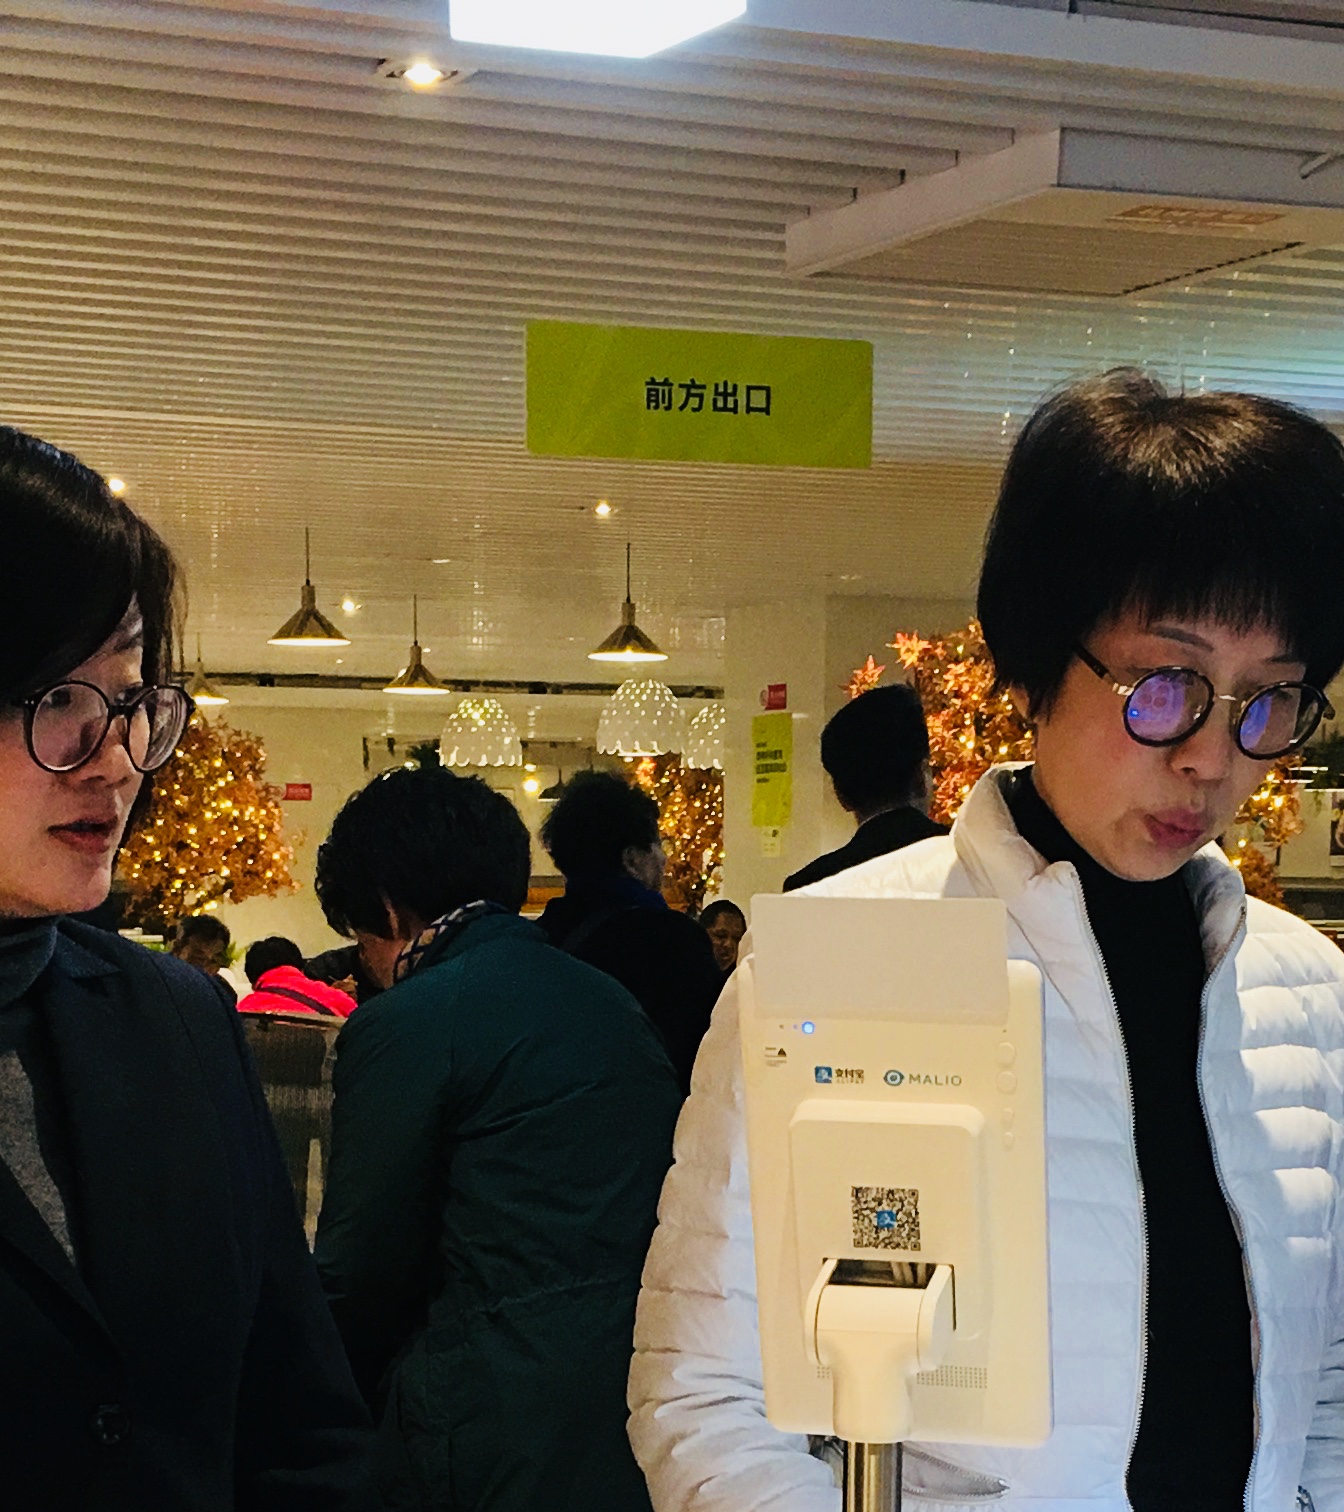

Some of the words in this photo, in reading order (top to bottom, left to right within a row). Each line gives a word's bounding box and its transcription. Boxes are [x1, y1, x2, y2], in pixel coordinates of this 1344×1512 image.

[645, 377, 771, 416] 前方出口
[909, 1073, 962, 1086] MALIO
